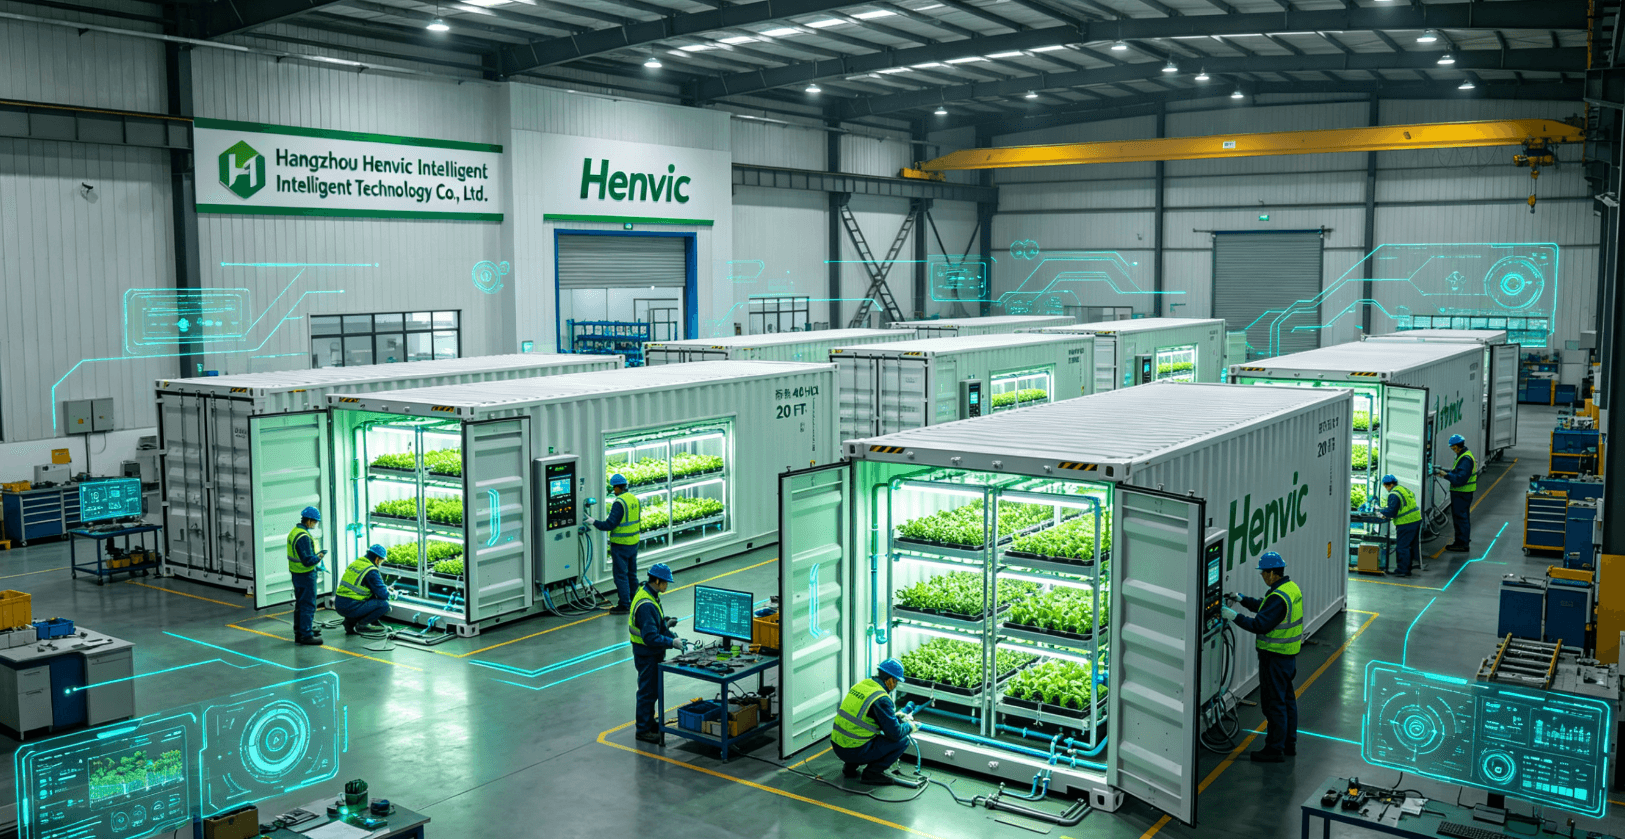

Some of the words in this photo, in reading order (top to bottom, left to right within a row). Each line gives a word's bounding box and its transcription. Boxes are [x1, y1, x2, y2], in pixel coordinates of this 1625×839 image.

[276, 148, 358, 172] Hangzhou
[363, 155, 413, 174] Henvic
[418, 159, 488, 181] Intelligent
[580, 157, 691, 204] Henvic
[276, 174, 352, 199] Intelligent
[355, 179, 432, 203] Technology
[436, 183, 460, 204] Co.,
[464, 185, 488, 202] Ltd.
[776, 404, 791, 419] 20
[1226, 471, 1309, 572] Henvic
